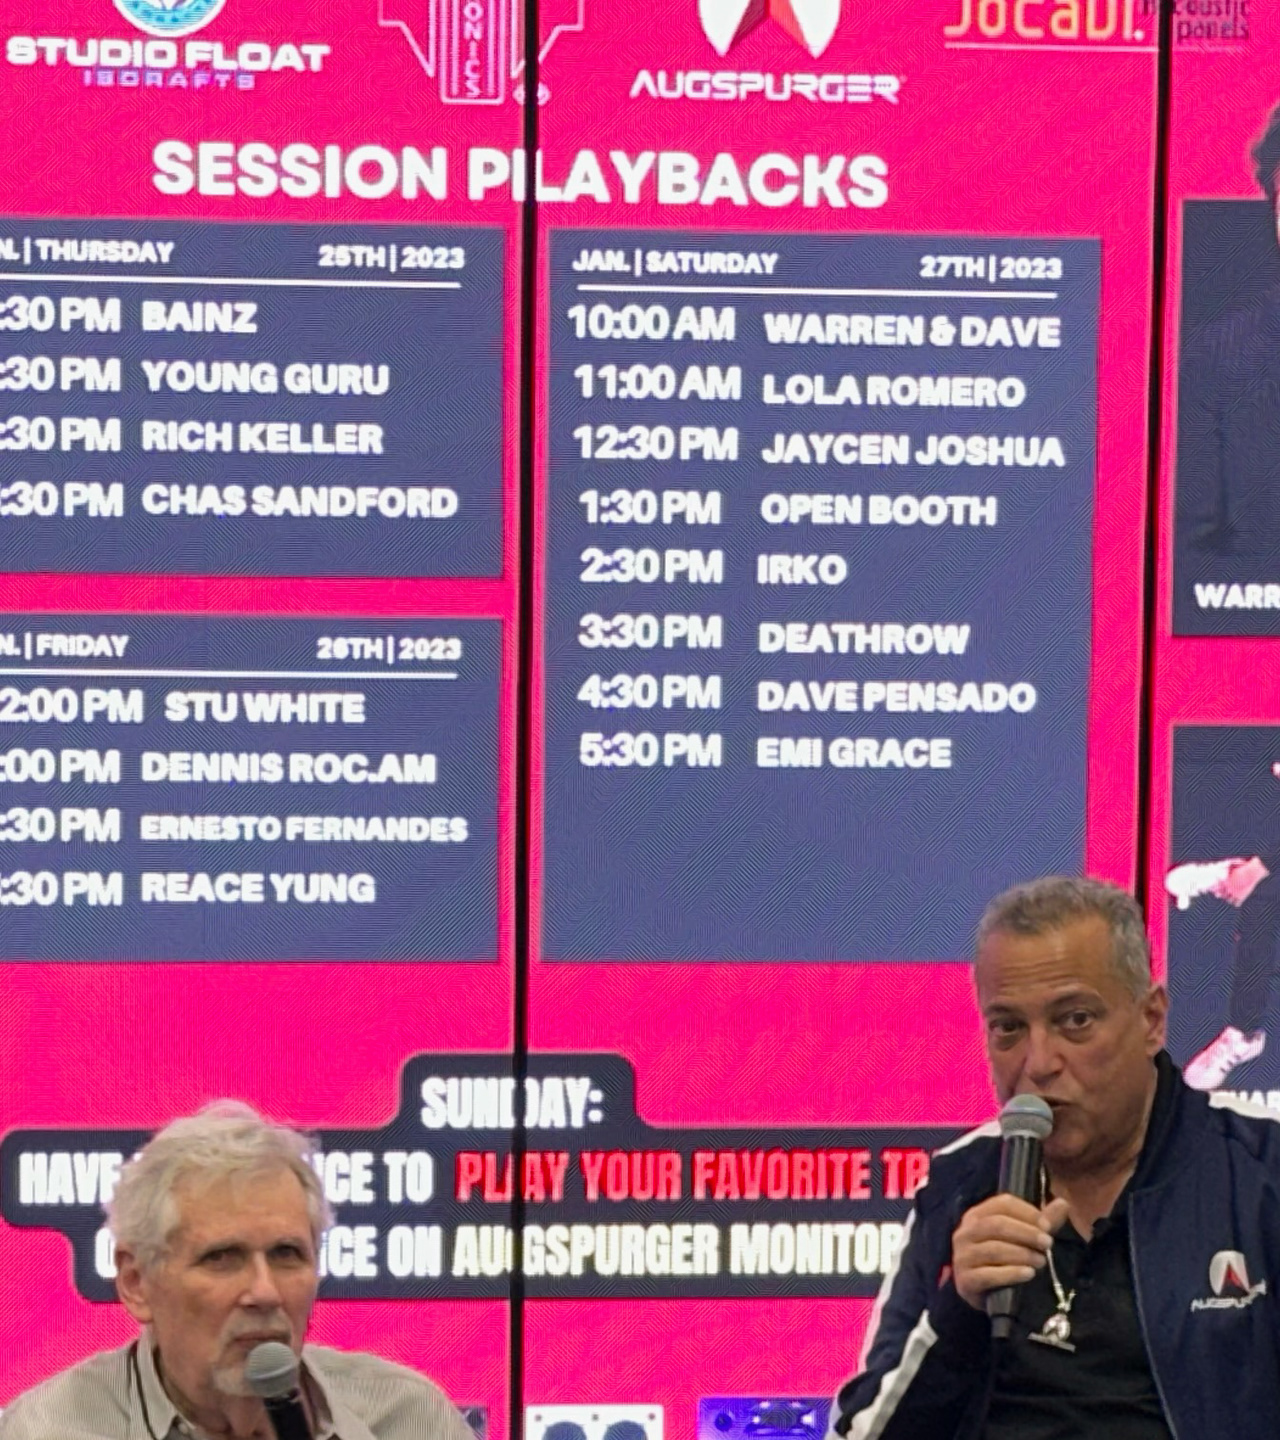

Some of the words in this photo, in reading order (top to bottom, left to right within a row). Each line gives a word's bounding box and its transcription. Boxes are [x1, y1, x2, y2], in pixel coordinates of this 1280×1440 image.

[6, 36, 179, 68] STUDIO
[185, 41, 332, 72] FLOAT
[629, 69, 900, 104] AUGSPURGER
[153, 140, 447, 200] SESSION
[468, 146, 889, 209] PLAYBACKS
[34, 238, 175, 264] THURSDAY
[318, 244, 387, 268] 25TH
[400, 245, 466, 269] 2023
[571, 249, 632, 272] JAN.
[645, 249, 779, 275] SATURDAY
[919, 254, 986, 279] 27TH
[999, 256, 1063, 280] 2023
[60, 296, 122, 333] PM
[141, 300, 258, 334] BAINZ
[567, 303, 671, 340] 10:00
[672, 305, 736, 341] AM
[763, 312, 920, 346] WARREN
[928, 314, 957, 347] &
[960, 315, 1062, 348] DAVE
[60, 356, 122, 392] PM
[140, 359, 279, 394] YOUNG
[283, 362, 390, 396] GURU
[573, 363, 677, 400] 11:00
[678, 364, 742, 401] AM
[762, 373, 863, 406] LOLA
[866, 374, 1027, 408] ROMERO
[60, 416, 122, 452] PM
[141, 420, 234, 453] RICH
[238, 421, 384, 455] KELLER
[572, 424, 676, 460] 12:30
[679, 426, 740, 461] PM
[761, 432, 910, 465] JAYCEN
[914, 434, 1066, 468] JOSHUA
[63, 481, 124, 518] PM
[141, 483, 248, 516] CHAS
[251, 484, 459, 519] SANDFORD
[578, 488, 659, 525] 1:30
[662, 489, 722, 525] PM
[760, 492, 863, 525] OPEN
[868, 494, 998, 527] BOOTH
[579, 547, 661, 583] 2:30
[664, 548, 724, 584] PM
[757, 553, 848, 586] IRKO
[36, 633, 130, 658] FRIDAY
[398, 637, 463, 661] 2023
[578, 612, 660, 649] 3:30
[663, 613, 723, 649] PM
[758, 622, 971, 655] DEATHROW
[82, 688, 144, 724] PM
[164, 690, 239, 723] STU
[242, 692, 366, 724] WHITE
[576, 673, 659, 709] 4:30
[662, 674, 722, 709] PM
[757, 680, 859, 712] DAVE
[862, 680, 1037, 713] PENSADO
[60, 748, 121, 784] PM
[141, 751, 285, 784] DENNIS
[579, 731, 660, 767] 5:30
[663, 732, 723, 767] PM
[756, 736, 824, 768] EMI
[828, 736, 953, 769] GRACE
[60, 807, 121, 843] PM
[140, 814, 283, 841] ERNESTO
[285, 815, 469, 843] FERNANDES
[62, 871, 124, 907] PM
[140, 871, 265, 903] REACE
[269, 872, 376, 904] YUNG
[420, 1075, 604, 1131] SUNDAY:
[384, 1150, 435, 1202] TO
[456, 1149, 570, 1203] PLAY
[580, 1149, 682, 1201] YOUR
[693, 1148, 871, 1200] FAVORITE
[387, 1225, 442, 1278] ON
[452, 1223, 719, 1277] AUGSPURGER
